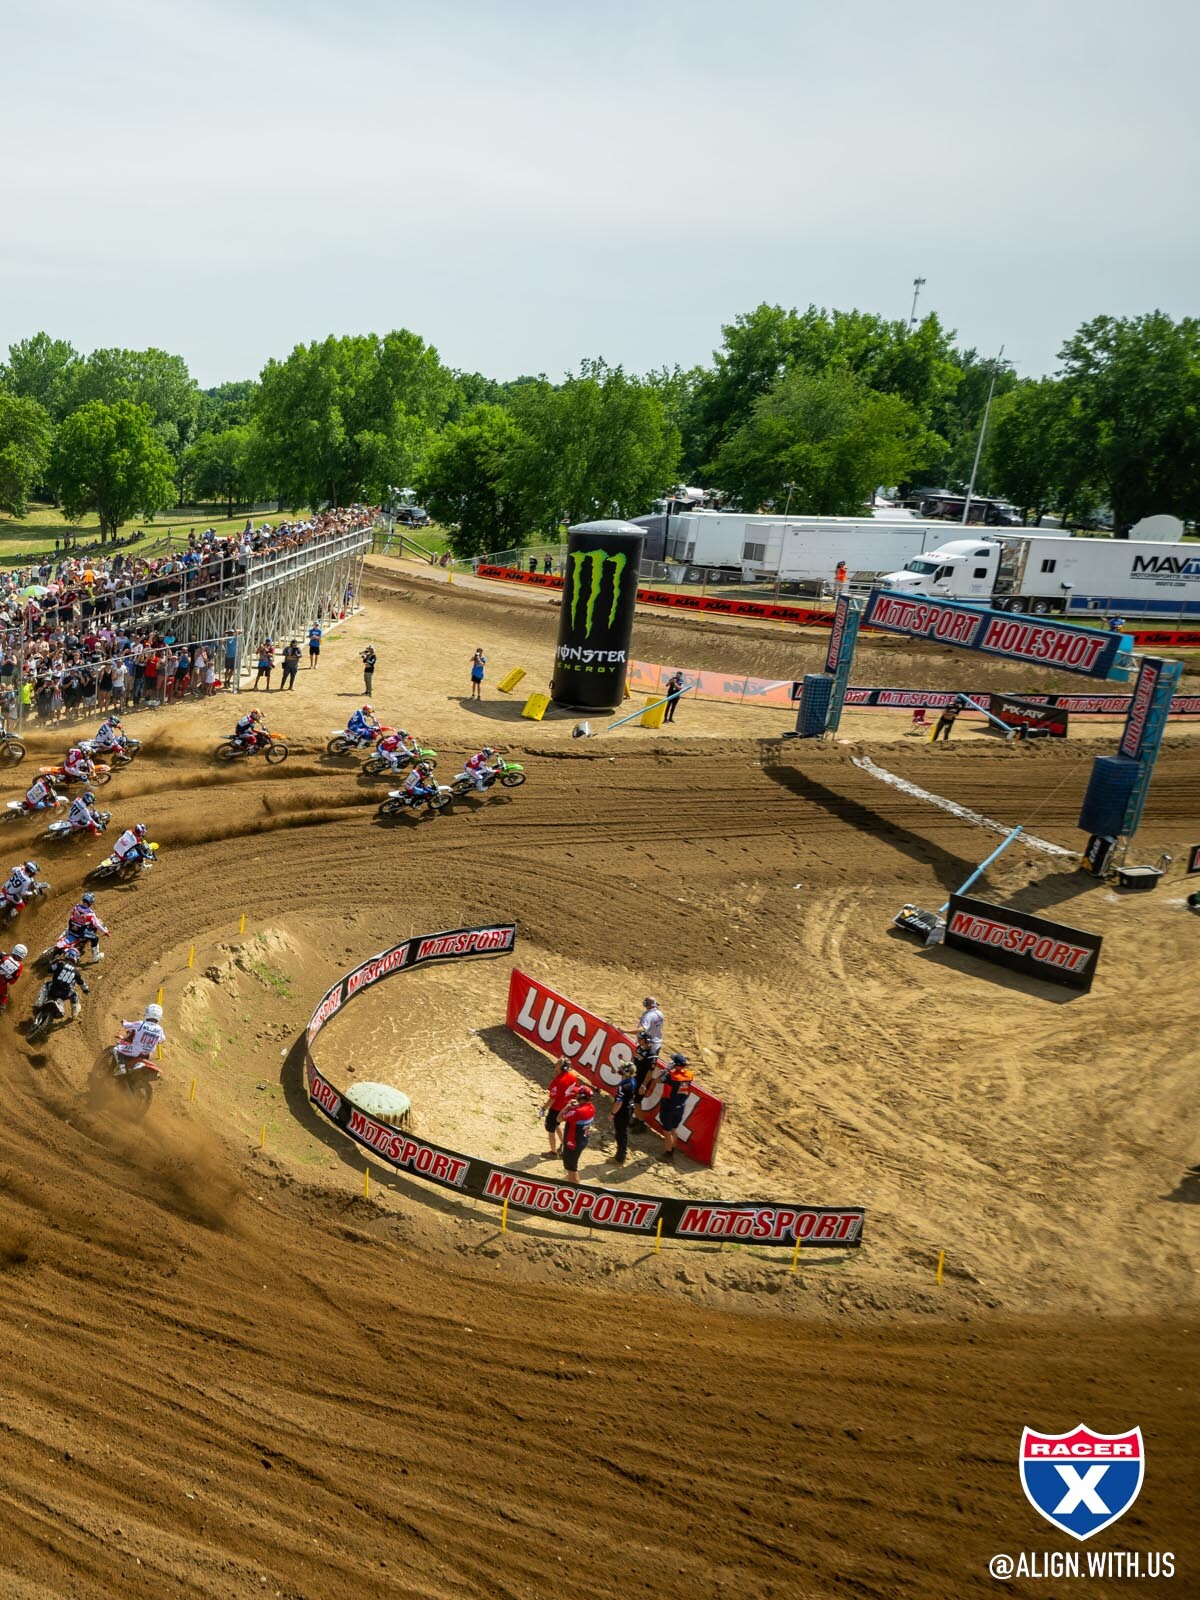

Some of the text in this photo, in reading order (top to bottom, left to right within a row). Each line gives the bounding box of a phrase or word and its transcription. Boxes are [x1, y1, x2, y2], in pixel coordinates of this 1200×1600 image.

[675, 599, 699, 607] KTM
[705, 602, 731, 610] KTM
[738, 606, 764, 615] KTM
[771, 610, 799, 619] KTM
[983, 620, 1105, 669] HOLESHOT
[516, 986, 634, 1086] LUCAS
